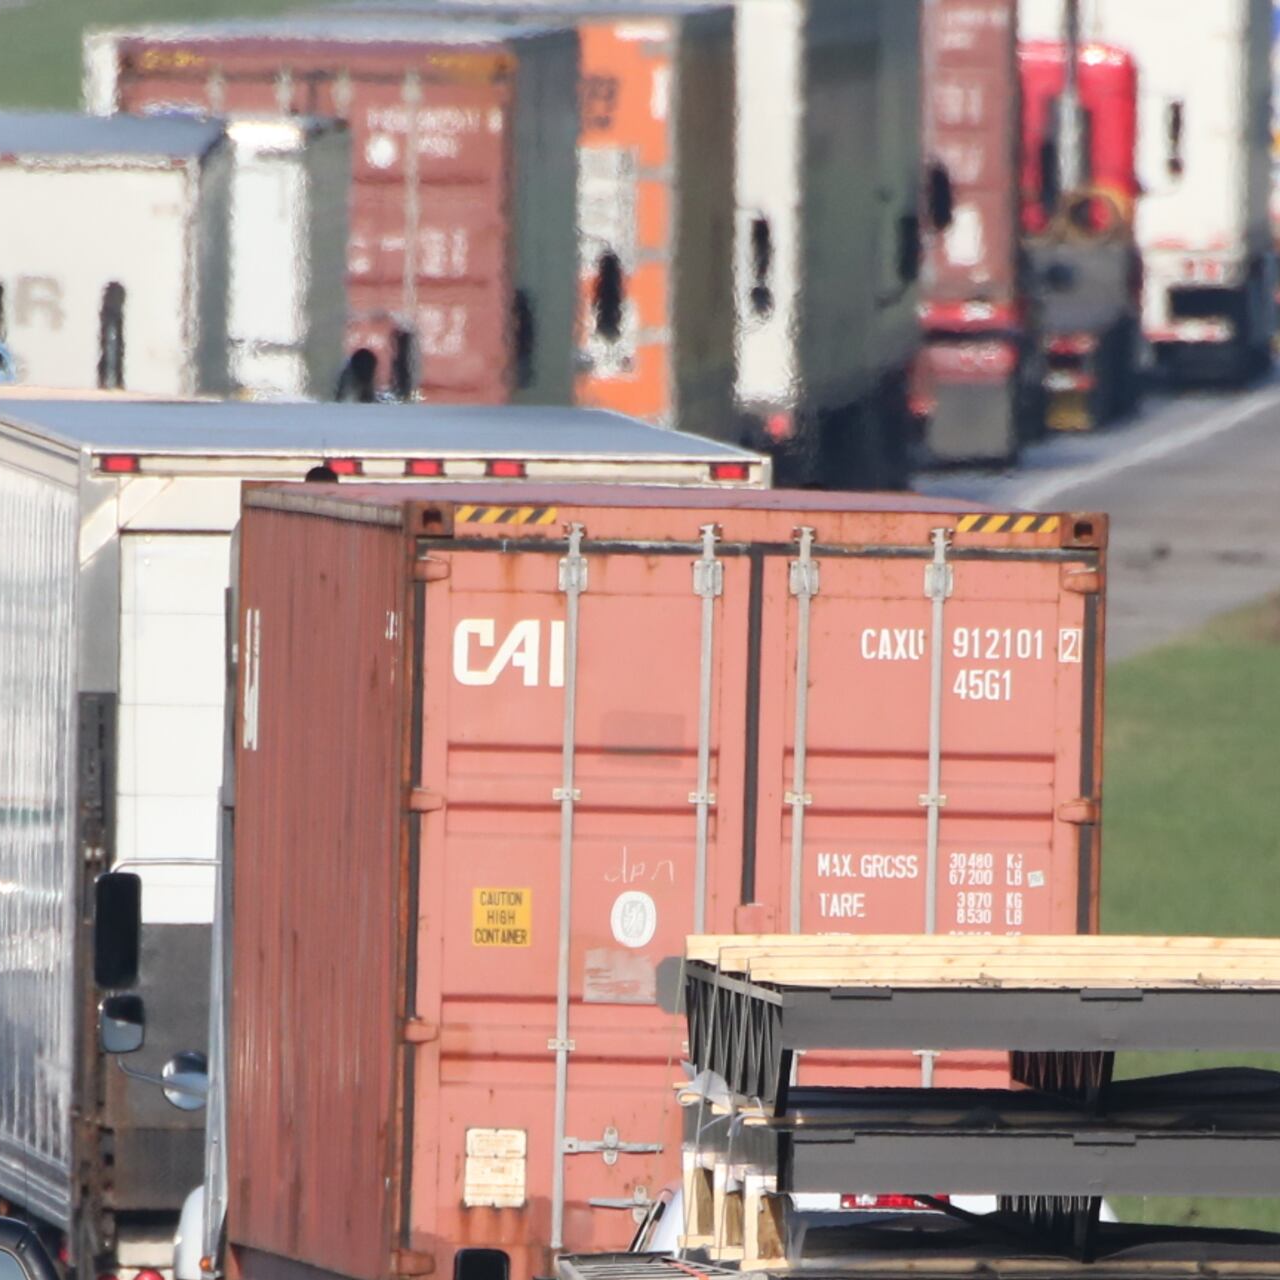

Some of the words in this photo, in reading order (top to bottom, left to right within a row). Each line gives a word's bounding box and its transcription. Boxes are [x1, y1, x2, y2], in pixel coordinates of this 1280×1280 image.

[861, 628, 925, 660] CAXU
[952, 627, 1043, 660] 912101
[1061, 629, 1078, 660] 2
[453, 618, 565, 688] CAI
[953, 669, 1011, 701] 45G1
[1006, 869, 1023, 886] LB
[480, 891, 523, 907] CAUTION
[1006, 892, 1023, 909] KG
[487, 910, 516, 926] HIGH
[1006, 909, 1023, 926] LB
[474, 928, 527, 945] CONTAINER
